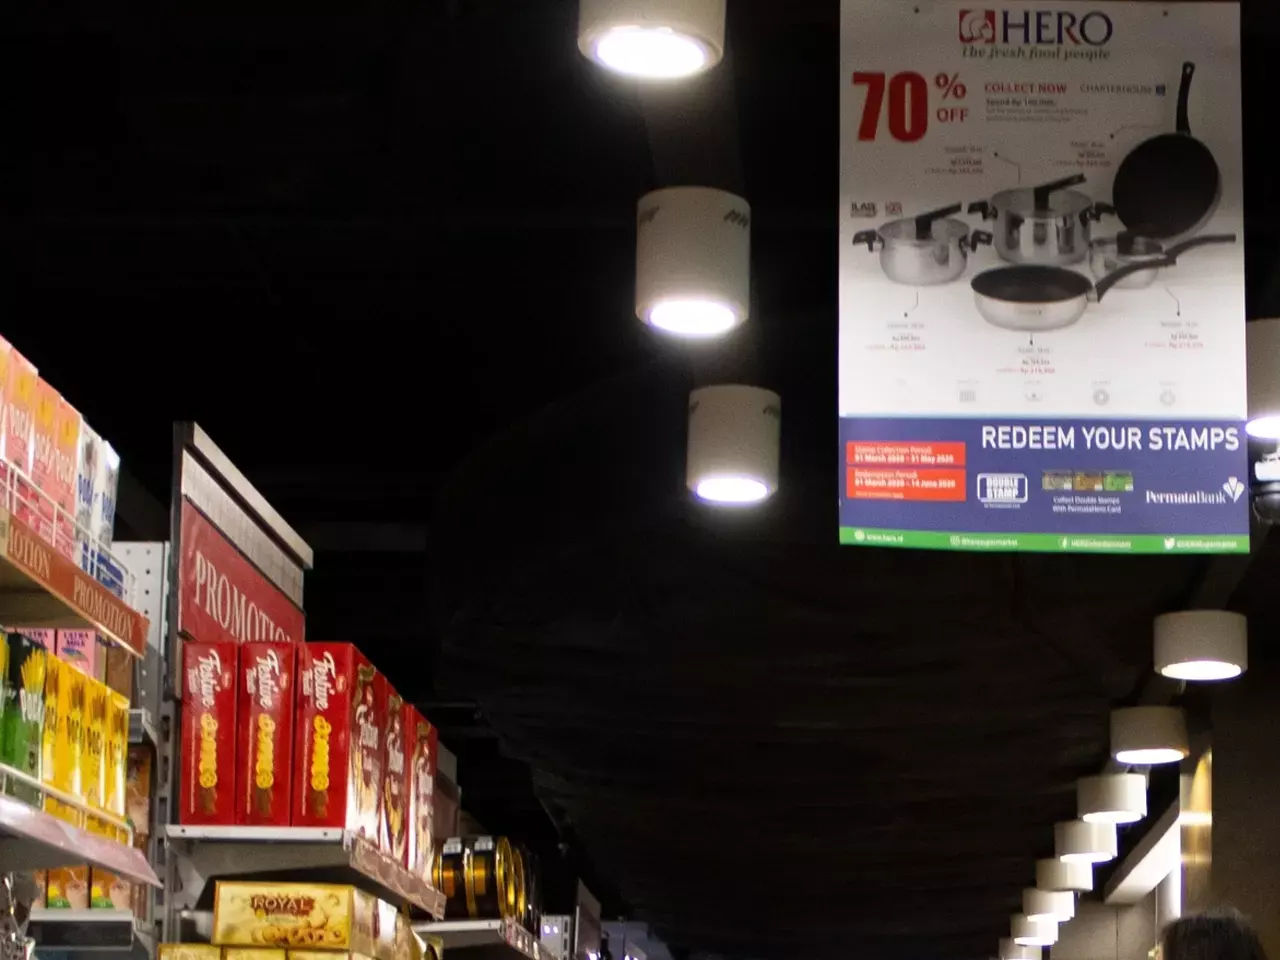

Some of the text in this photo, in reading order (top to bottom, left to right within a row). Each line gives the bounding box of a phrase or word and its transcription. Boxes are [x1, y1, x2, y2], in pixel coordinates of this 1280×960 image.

[1002, 10, 1113, 46] HERO
[988, 46, 1027, 60] fresh
[1028, 46, 1061, 61] food
[1063, 48, 1111, 62] people
[984, 82, 1067, 94] COLLECT NOW
[851, 71, 928, 143] 70
[936, 107, 969, 123] OFF
[981, 425, 1240, 452] REDEEM YOUR STAMPS
[986, 476, 1019, 487] DOUBLE
[986, 488, 1019, 500] STAMP
[1145, 489, 1226, 505] PermataBank
[73, 573, 134, 641] PROMOTION
[199, 648, 221, 710] Festive
[256, 648, 280, 710] Festive
[313, 651, 336, 712] Festive
[252, 895, 313, 911] ROYAL
